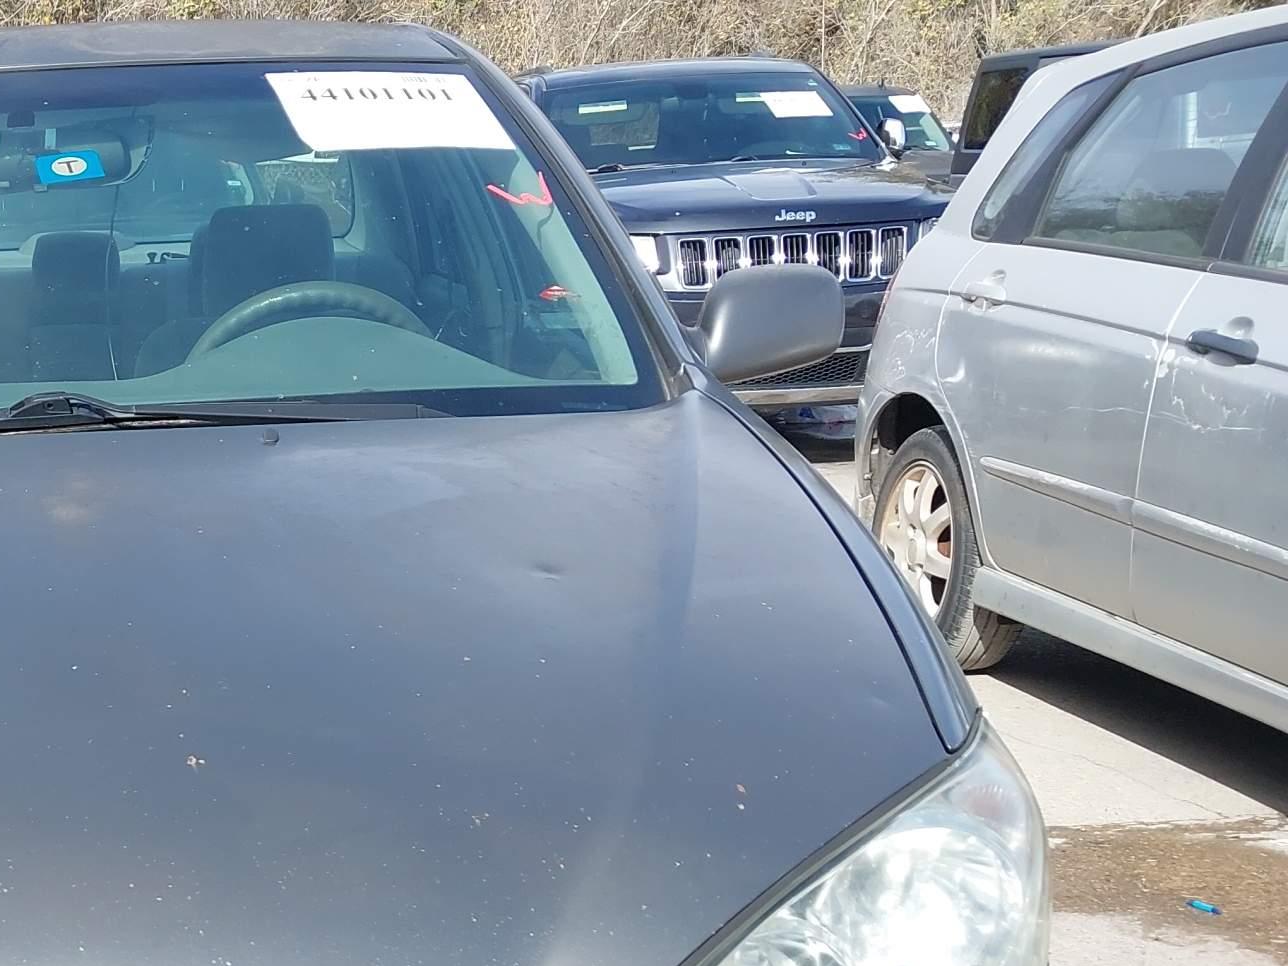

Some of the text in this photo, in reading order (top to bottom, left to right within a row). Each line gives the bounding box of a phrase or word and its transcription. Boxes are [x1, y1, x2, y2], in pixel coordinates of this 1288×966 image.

[300, 87, 453, 101] 44101101
[57, 159, 78, 173] T
[775, 209, 816, 223] Jeep
